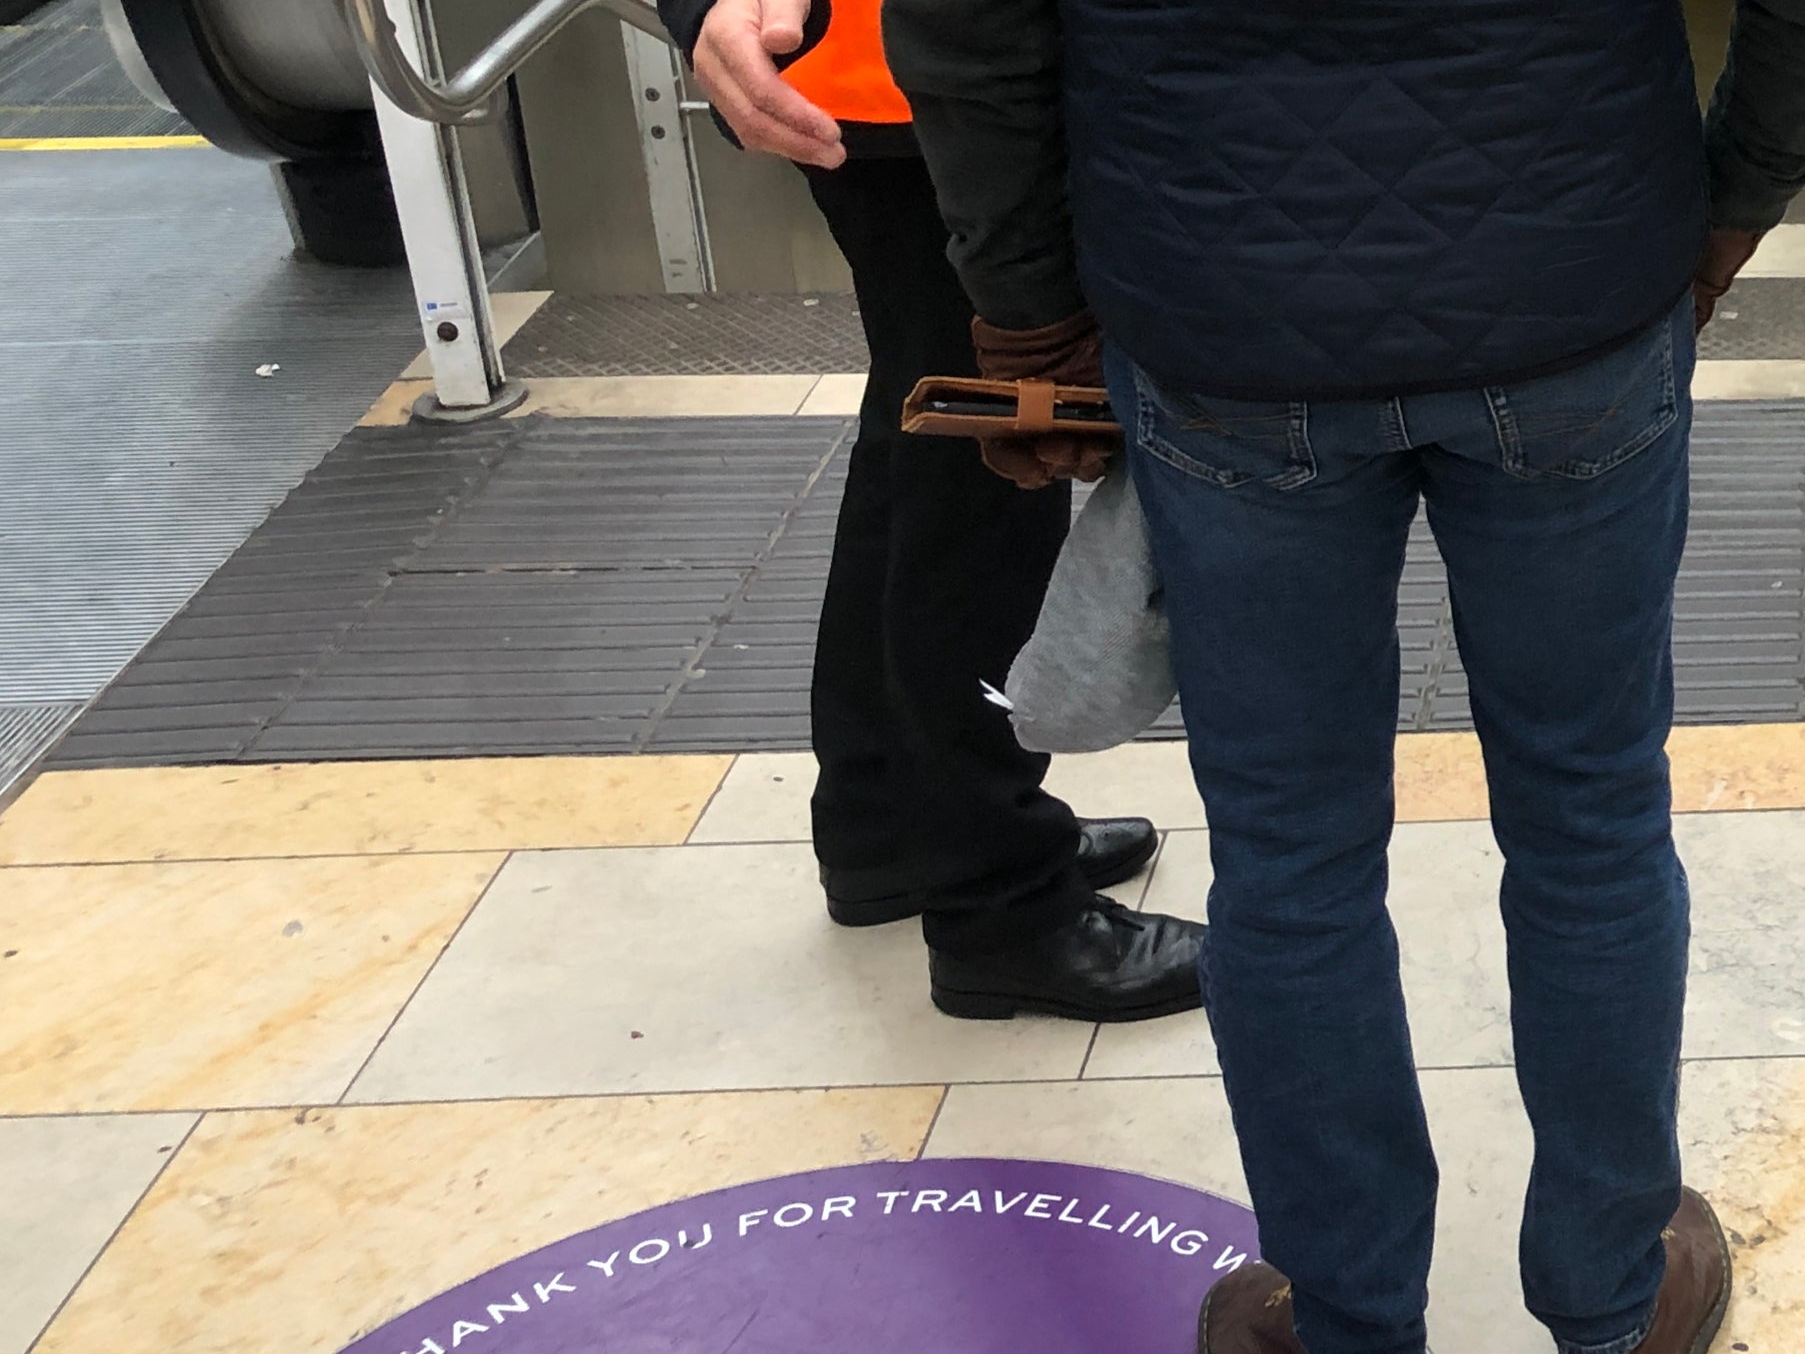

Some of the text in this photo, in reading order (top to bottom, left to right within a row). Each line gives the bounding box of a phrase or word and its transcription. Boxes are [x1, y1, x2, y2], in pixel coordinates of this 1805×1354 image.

[587, 1224, 712, 1277] YOU
[739, 1196, 857, 1236] FOR
[877, 1189, 1208, 1255] TRAVELLING
